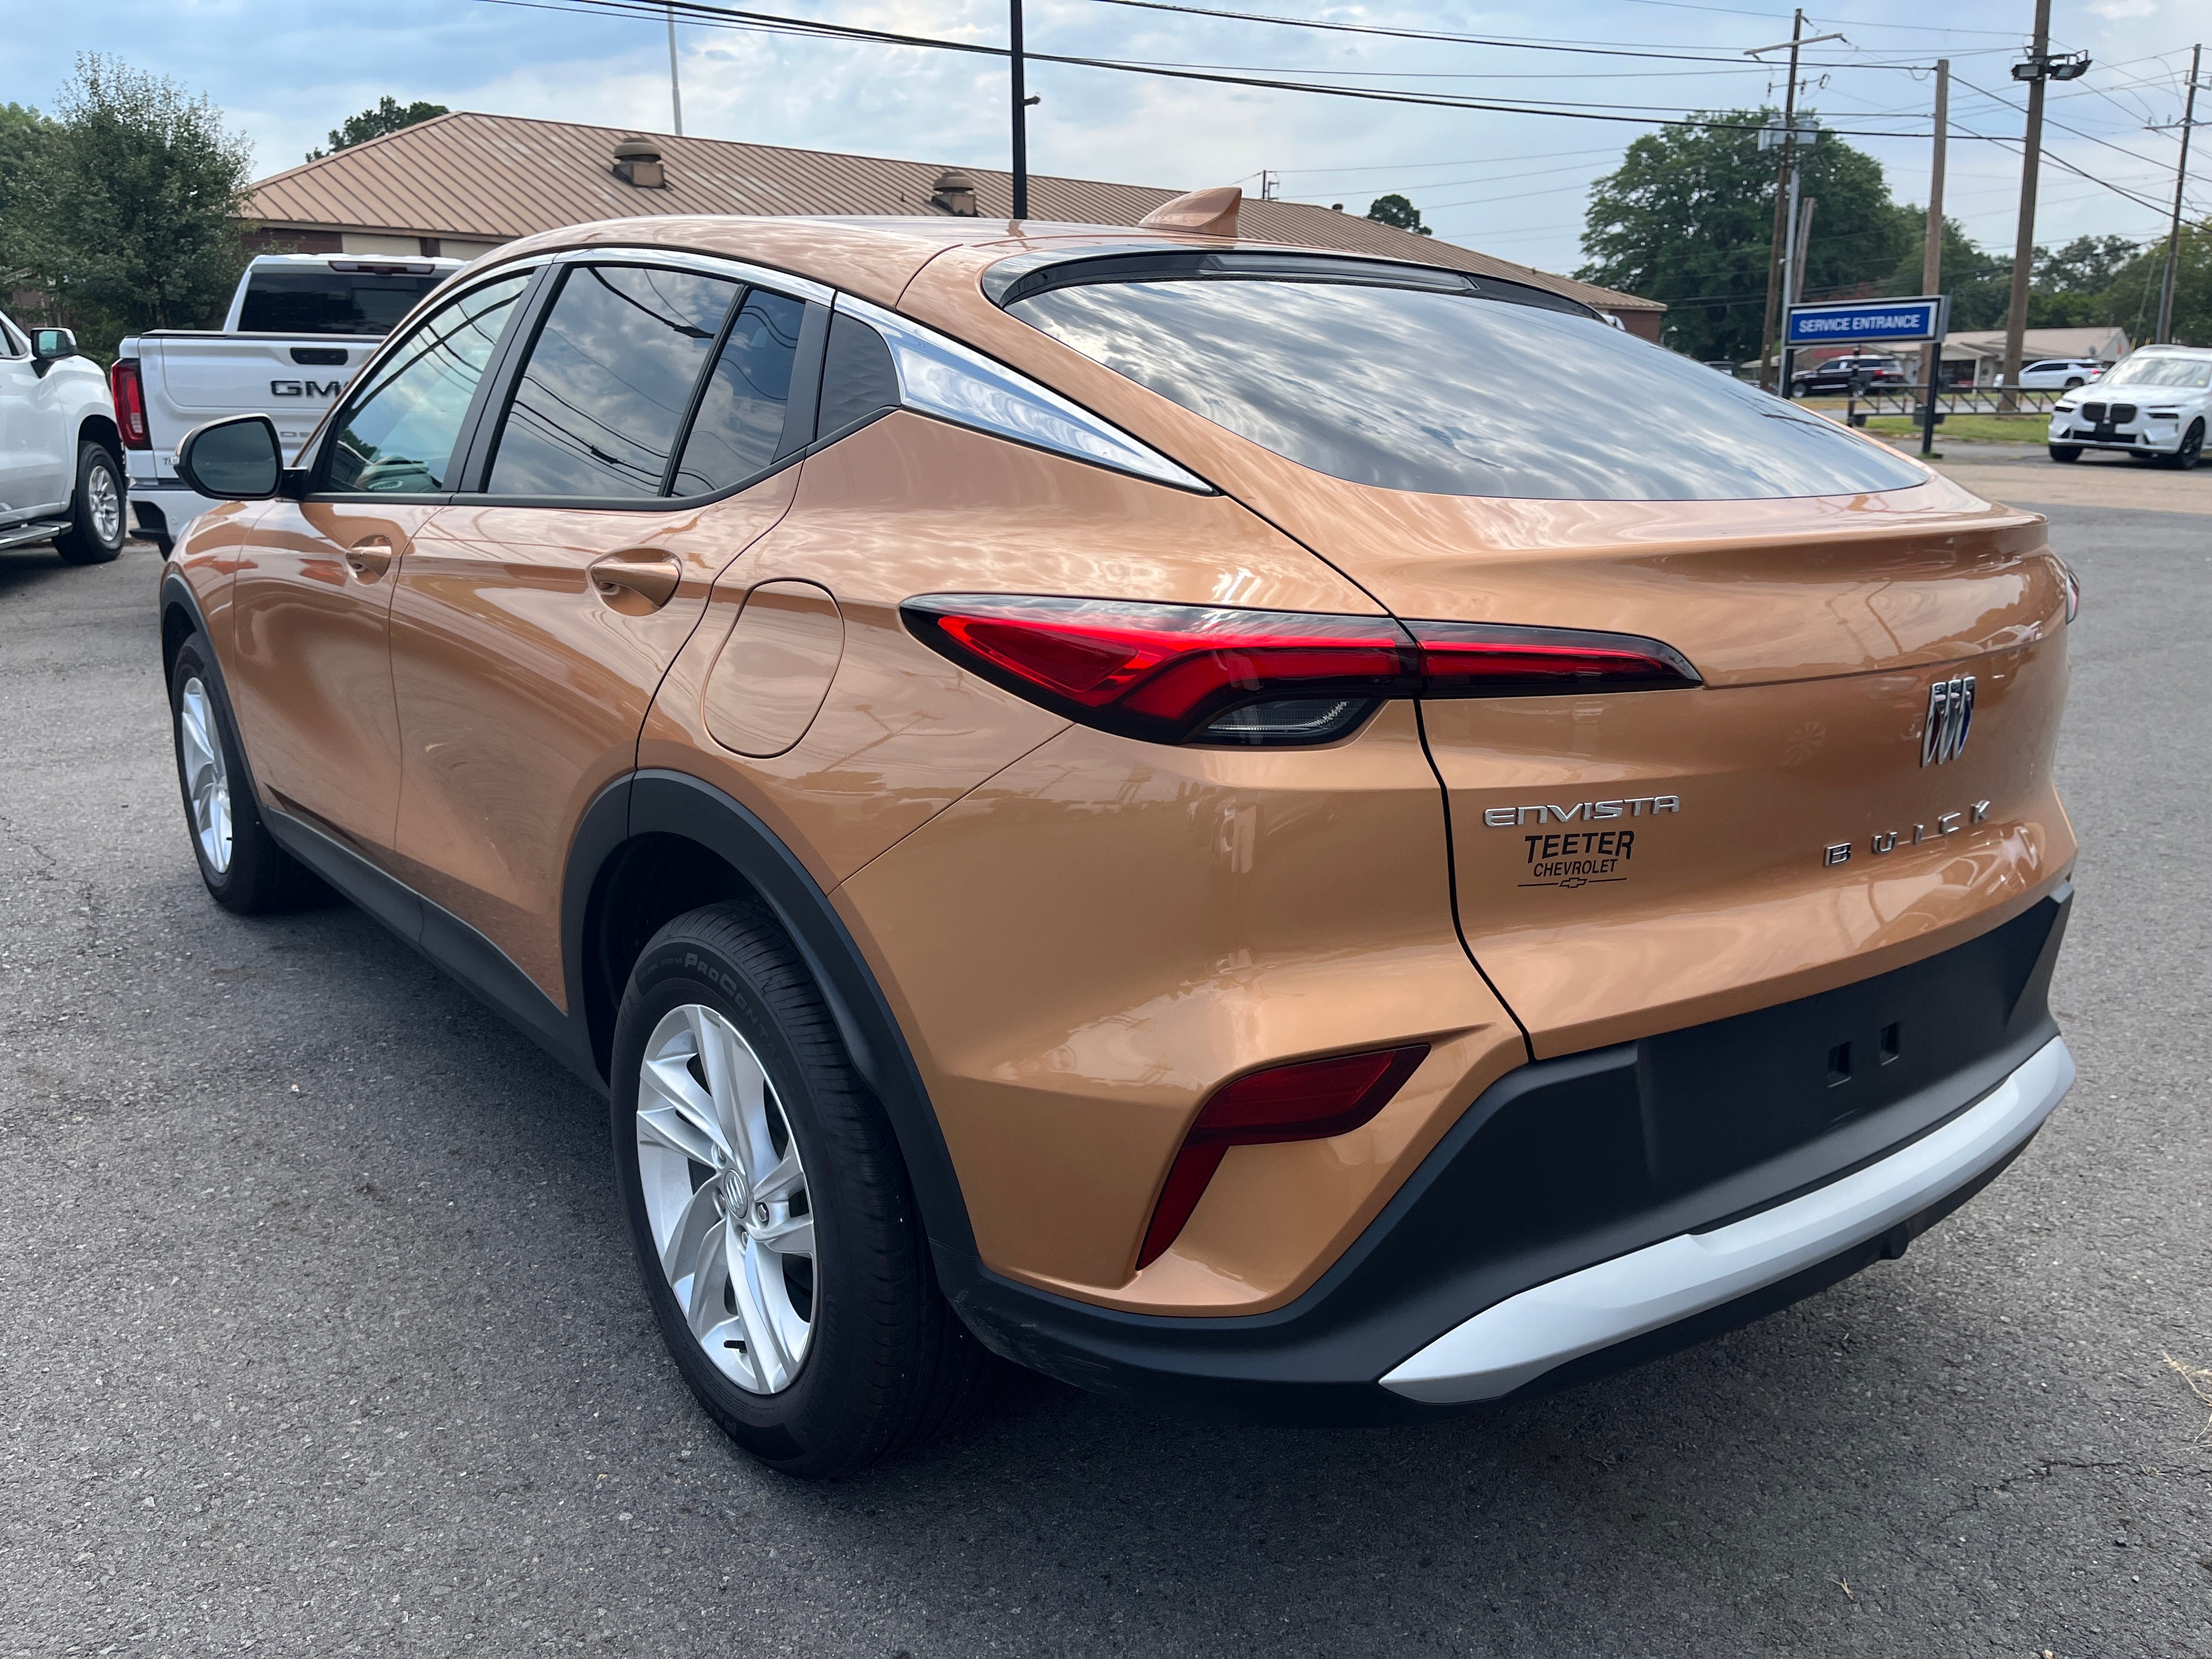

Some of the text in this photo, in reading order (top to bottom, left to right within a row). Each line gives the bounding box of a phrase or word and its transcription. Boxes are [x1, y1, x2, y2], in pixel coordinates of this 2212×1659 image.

[1798, 314, 1921, 333] SERVICE ENTRANCE
[270, 380, 350, 398] GM
[1484, 795, 1680, 827] ENVISTA
[1824, 799, 1991, 867] BUICK
[1525, 830, 1635, 864] TEETER
[1533, 859, 1618, 877] CHEVROLET
